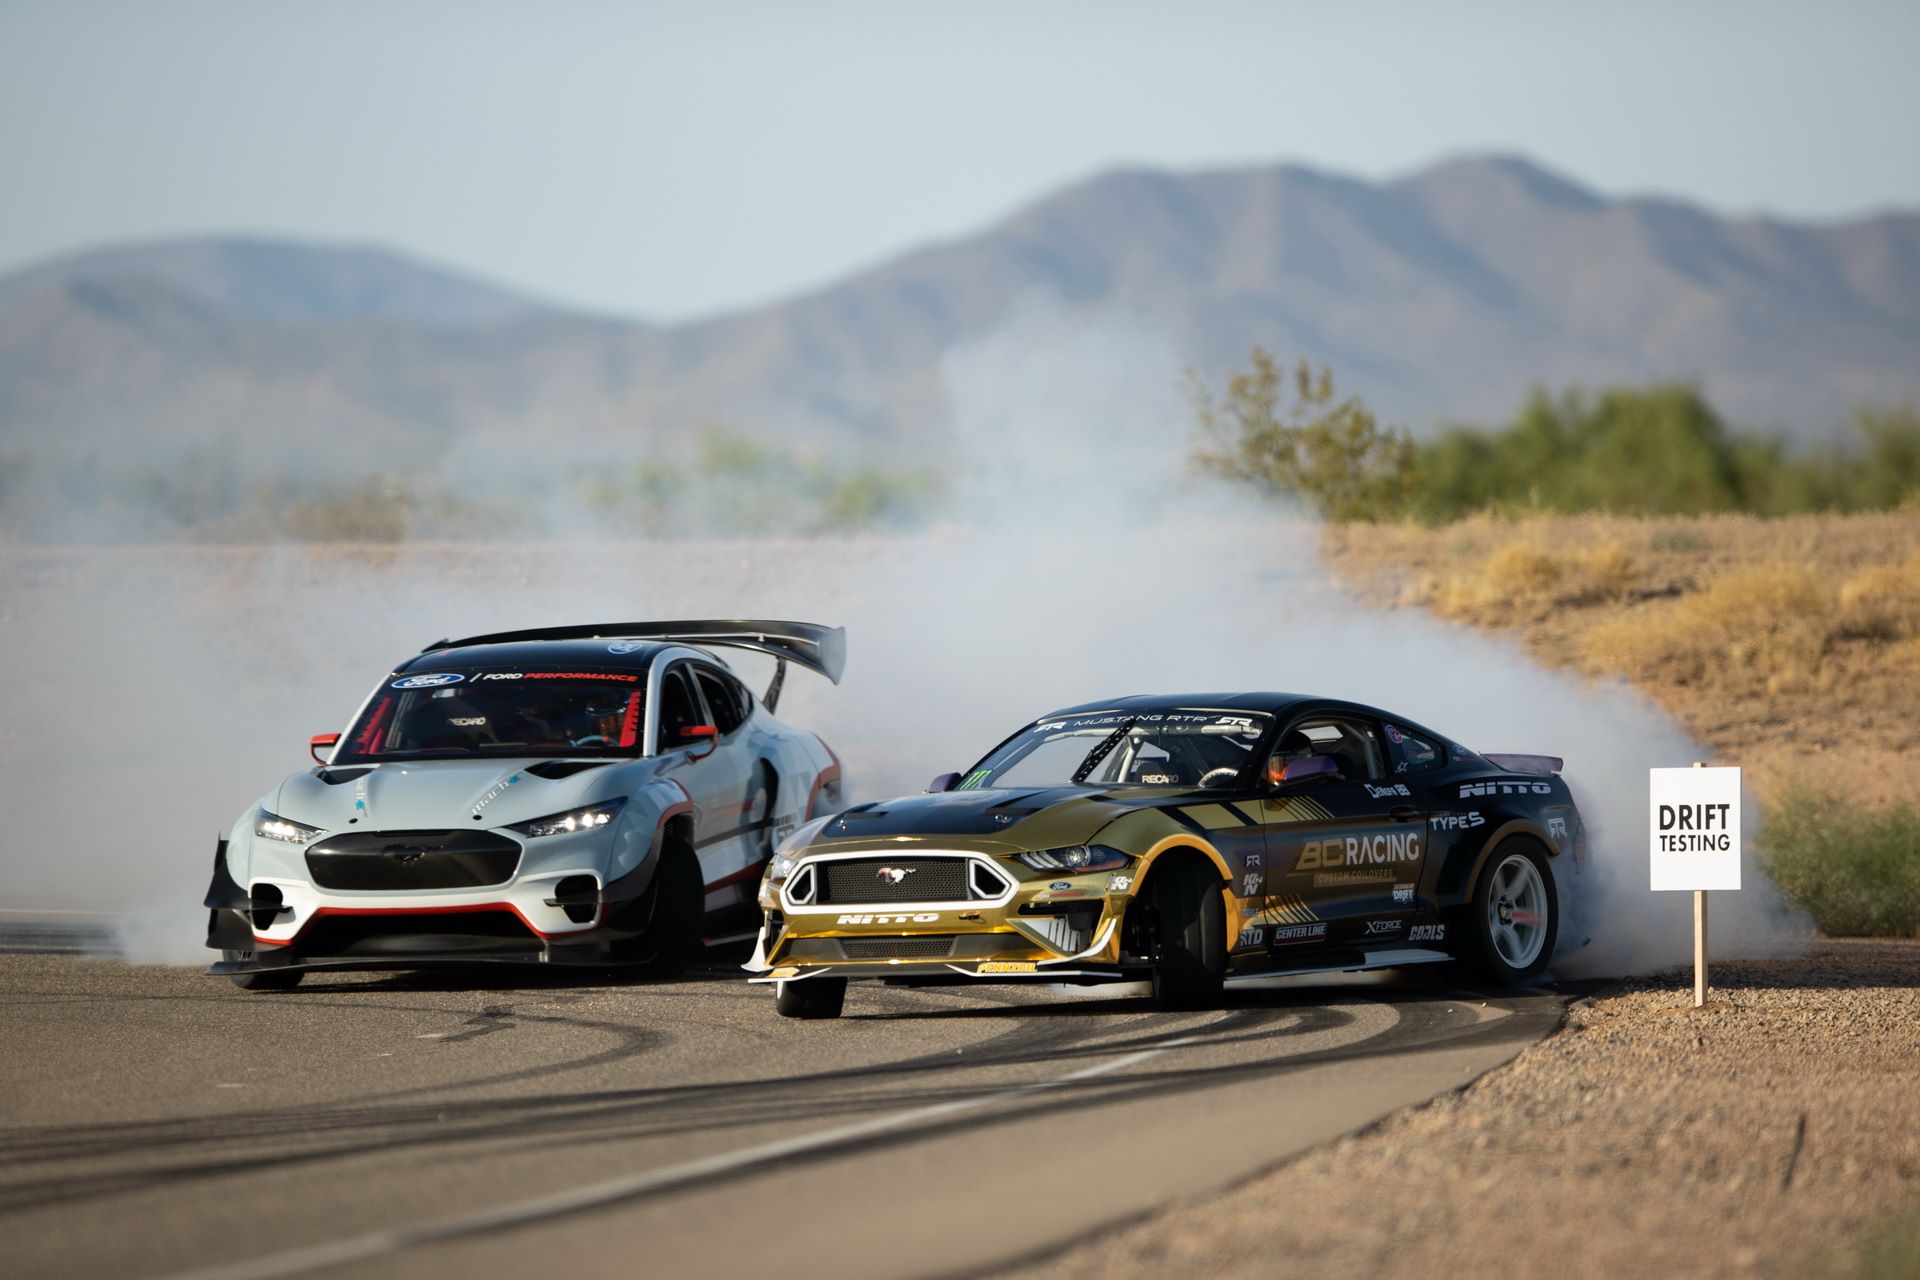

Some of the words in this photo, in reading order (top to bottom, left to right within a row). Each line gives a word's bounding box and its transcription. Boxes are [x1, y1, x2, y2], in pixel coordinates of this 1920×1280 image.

[482, 673, 523, 681] FORD
[523, 673, 639, 682] PERFORMANCE
[1073, 714, 1164, 727] MUSTANG
[1166, 714, 1208, 722] RTR
[1141, 774, 1179, 784] RECARO
[1459, 781, 1552, 799] NITTO
[1659, 803, 1730, 830] DRIFT
[1659, 833, 1731, 852] TESTING
[836, 912, 940, 925] NITTO
[1275, 927, 1307, 940] CENTER
[1307, 924, 1326, 937] LINE
